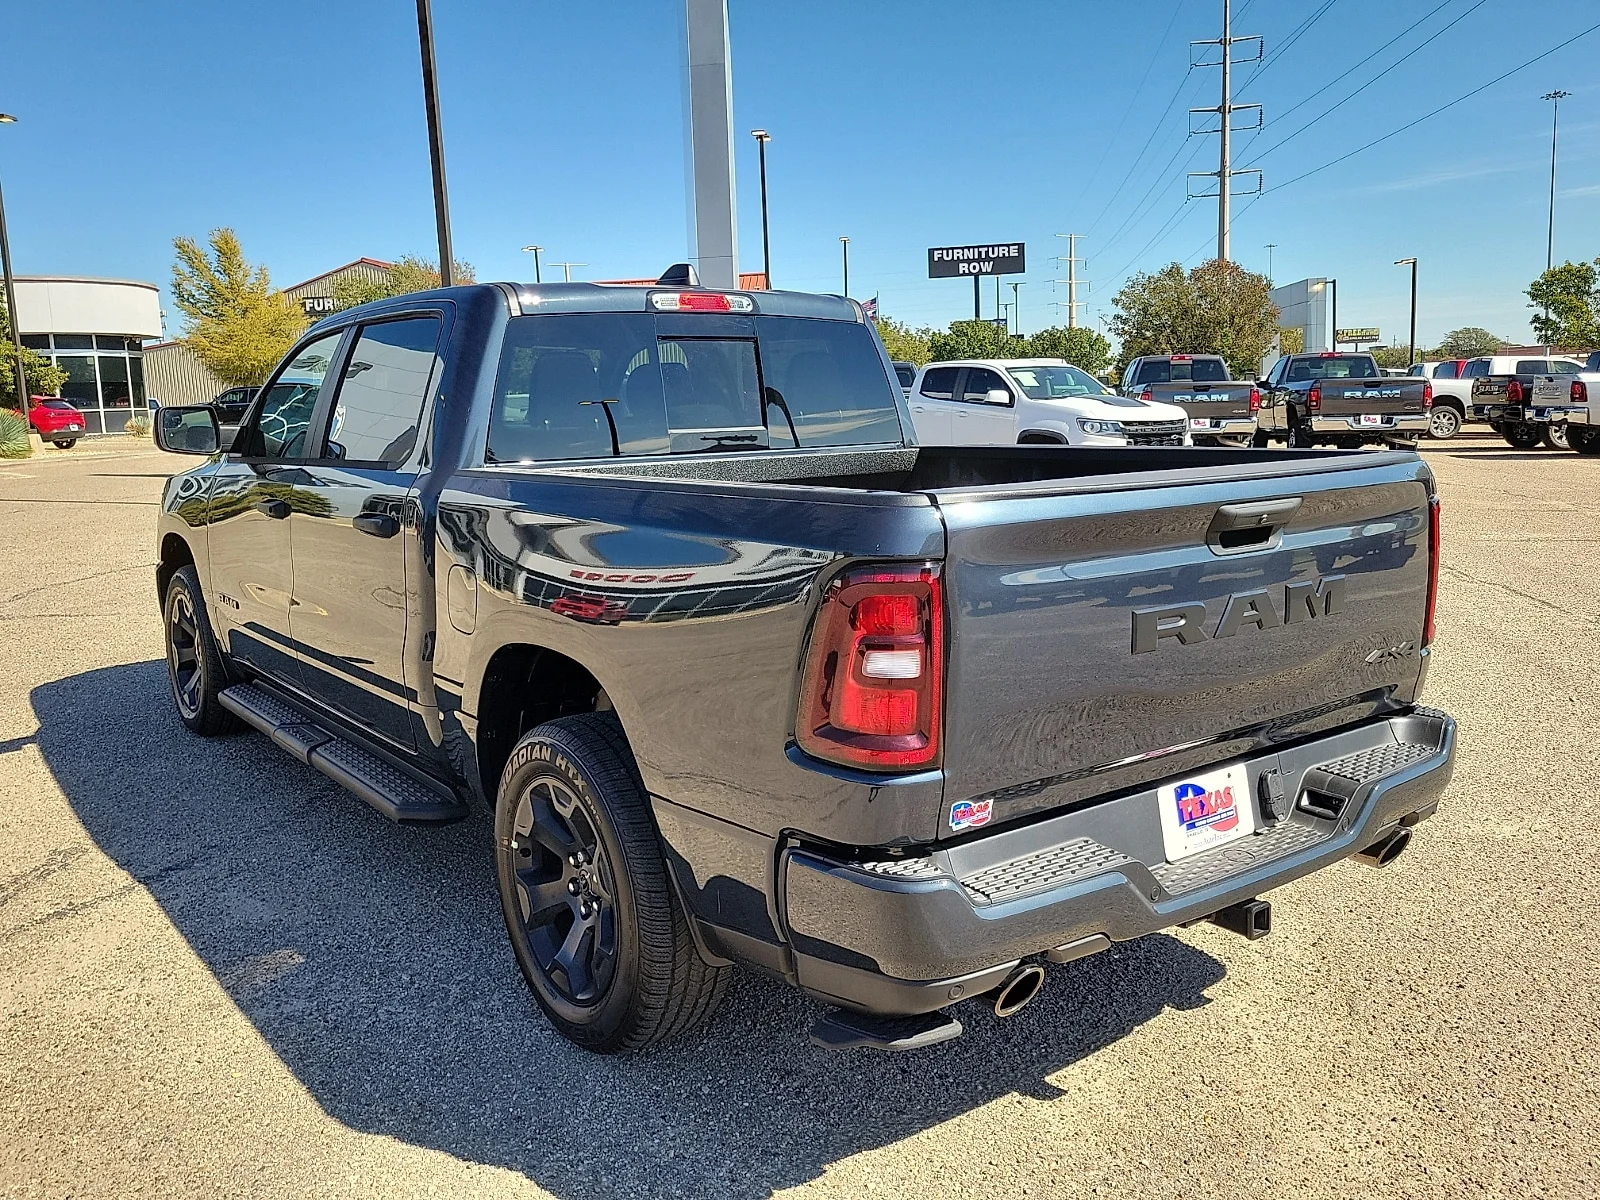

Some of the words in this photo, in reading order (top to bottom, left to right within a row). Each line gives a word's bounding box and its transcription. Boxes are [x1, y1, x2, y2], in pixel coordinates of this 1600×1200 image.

[933, 245, 1019, 261] FURNITURE
[959, 261, 994, 274] ROW
[1173, 394, 1229, 403] RAM
[1343, 389, 1401, 399] RAM
[1130, 574, 1346, 655] RAM
[555, 753, 587, 794] HTX
[954, 802, 989, 820] TEXAS
[1178, 786, 1233, 822] TEXAS
